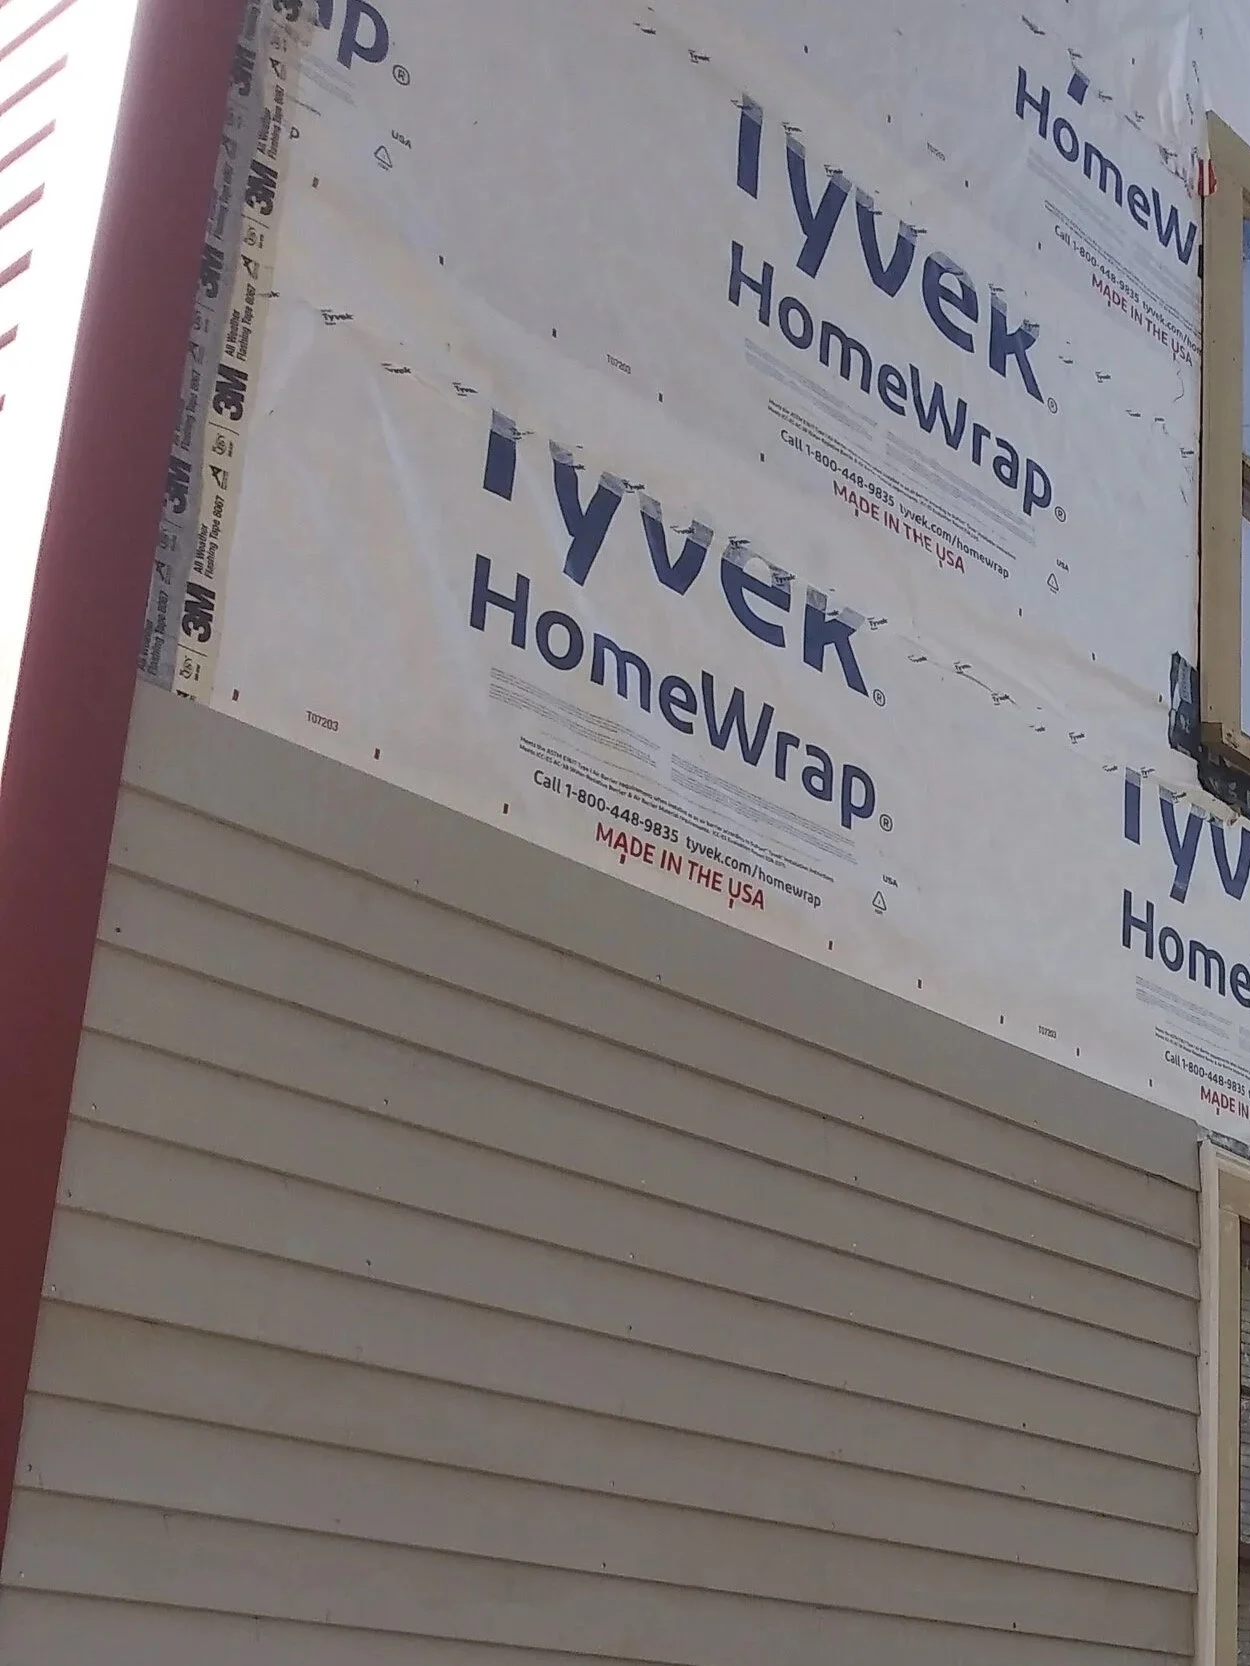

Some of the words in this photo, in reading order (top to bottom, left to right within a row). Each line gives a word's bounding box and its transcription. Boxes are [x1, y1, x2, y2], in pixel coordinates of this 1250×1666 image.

[245, 159, 279, 216] 3M
[1015, 65, 1198, 266] HomeW
[1054, 224, 1071, 247] Call
[1092, 273, 1128, 314] MADE
[1130, 305, 1144, 326] IN
[1145, 317, 1168, 346] THE
[1171, 338, 1194, 367] USA
[212, 363, 249, 422] 3M
[728, 240, 1054, 517] HomeWrap
[210, 516, 222, 541] Tape
[780, 429, 803, 452] Call
[805, 443, 896, 507] 1-800-448-9835
[899, 503, 1010, 580] tyvek.com/homewrap
[833, 479, 880, 523] MADE
[883, 511, 900, 535] IN
[903, 522, 933, 554] THE
[936, 543, 966, 575] USA
[203, 537, 218, 580] Flashing
[181, 581, 217, 643] 3M
[306, 710, 340, 732] T07203
[469, 553, 877, 830] HomeWrap
[533, 769, 561, 794] Call
[564, 783, 679, 844] 1-800-448-9835
[685, 834, 822, 909] tyvek.com/homewrap
[595, 821, 655, 866] MADE
[659, 849, 682, 875] IN
[687, 860, 723, 893] THE
[728, 878, 765, 911] USA
[1164, 1050, 1181, 1068] Call
[1181, 1058, 1246, 1097] 1-800-448-9835
[1200, 1085, 1236, 1111] MADE
[1238, 1100, 1249, 1119] IN
